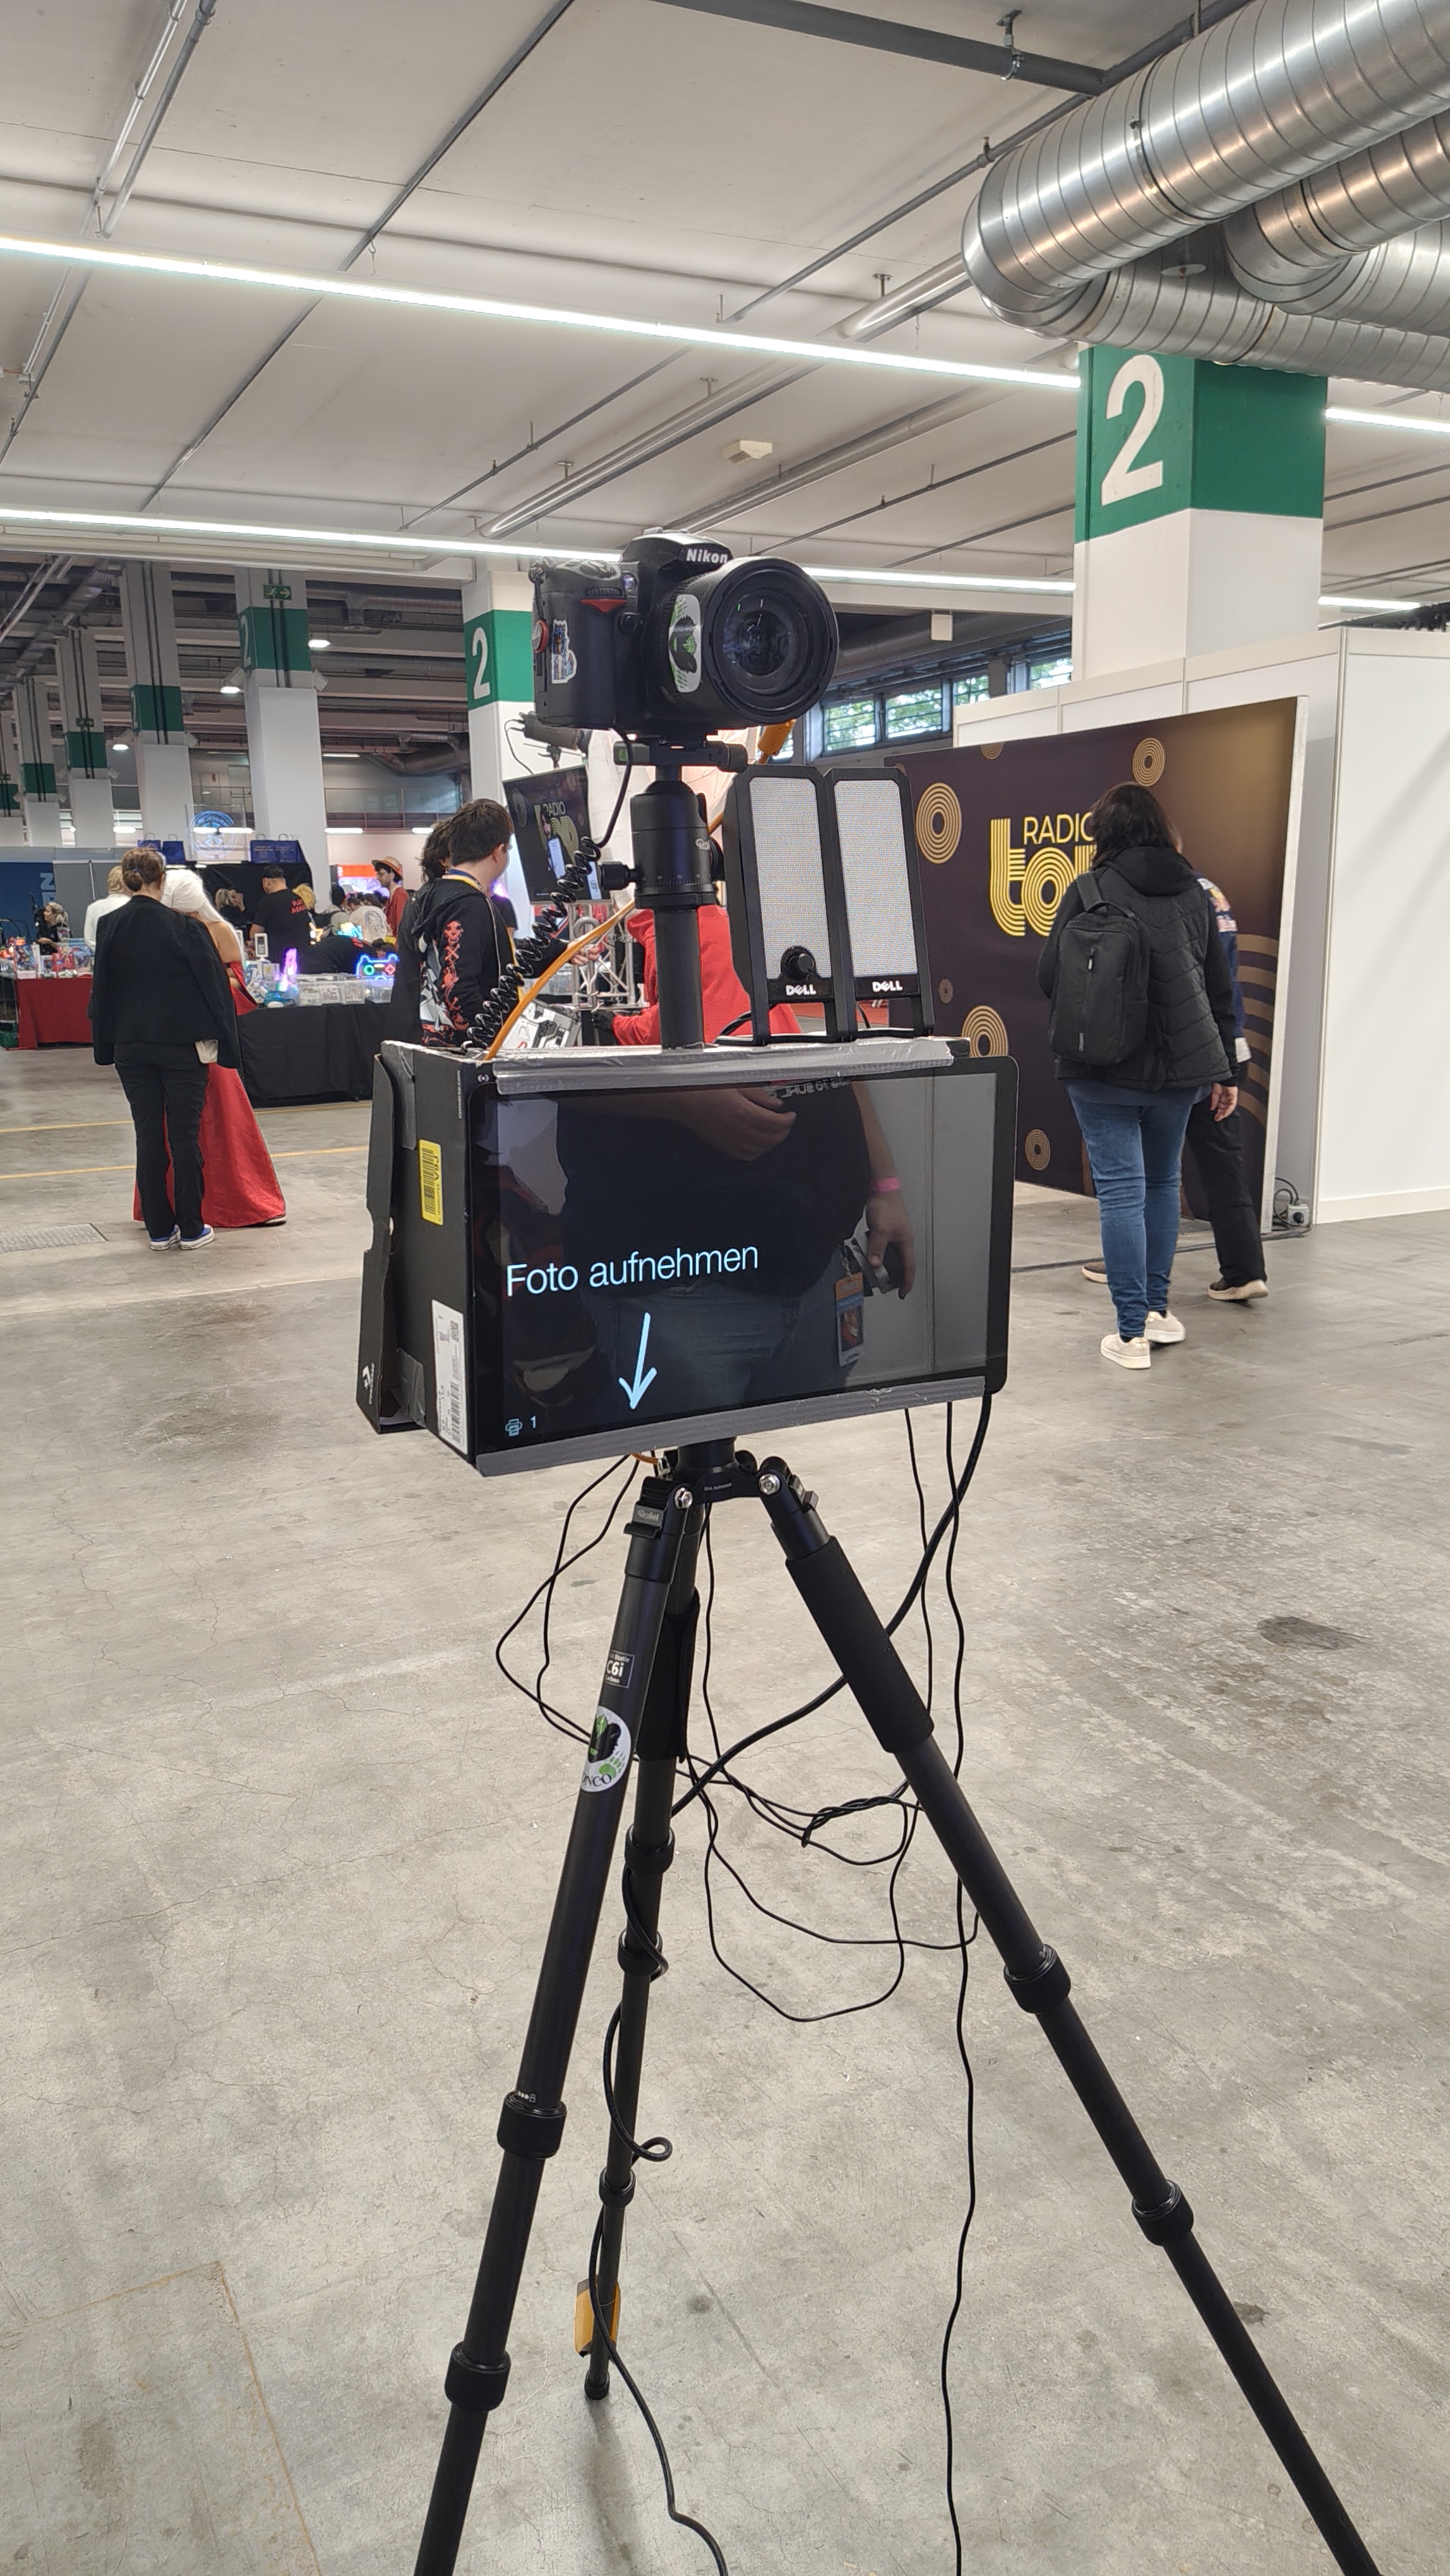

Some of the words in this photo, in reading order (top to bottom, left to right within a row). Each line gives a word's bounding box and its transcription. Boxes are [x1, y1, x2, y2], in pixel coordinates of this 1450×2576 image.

[1101, 354, 1165, 506] 2
[686, 548, 729, 564] Nikon
[472, 627, 491, 700] 2
[786, 984, 817, 996] DELL
[872, 981, 903, 993] DELL
[506, 1263, 579, 1297] Foto
[589, 1246, 758, 1288] aufnehmen
[530, 1415, 536, 1429] 1
[606, 1660, 625, 1678] C6i
